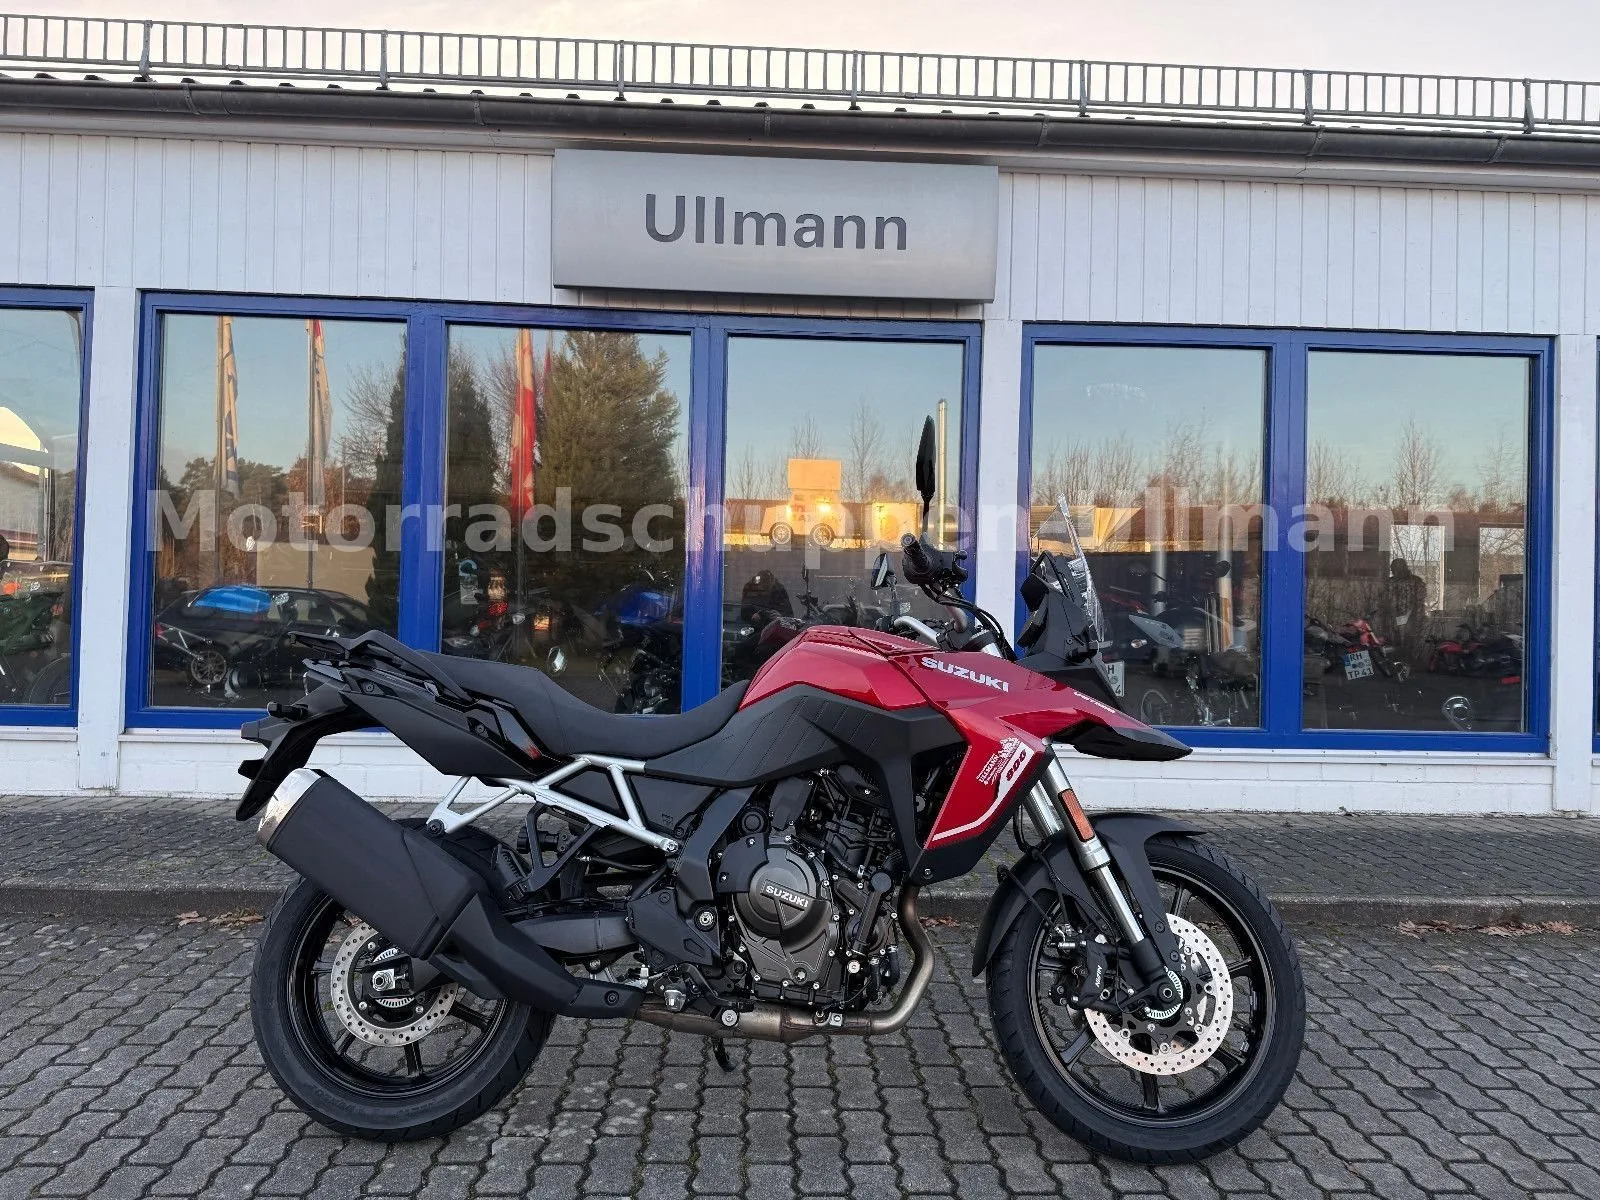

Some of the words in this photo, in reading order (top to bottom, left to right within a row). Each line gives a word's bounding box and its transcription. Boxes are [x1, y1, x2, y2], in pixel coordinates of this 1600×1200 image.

[645, 193, 907, 250] Ullmann
[921, 656, 1009, 692] SUZUKI
[765, 885, 809, 908] SUZUKI
